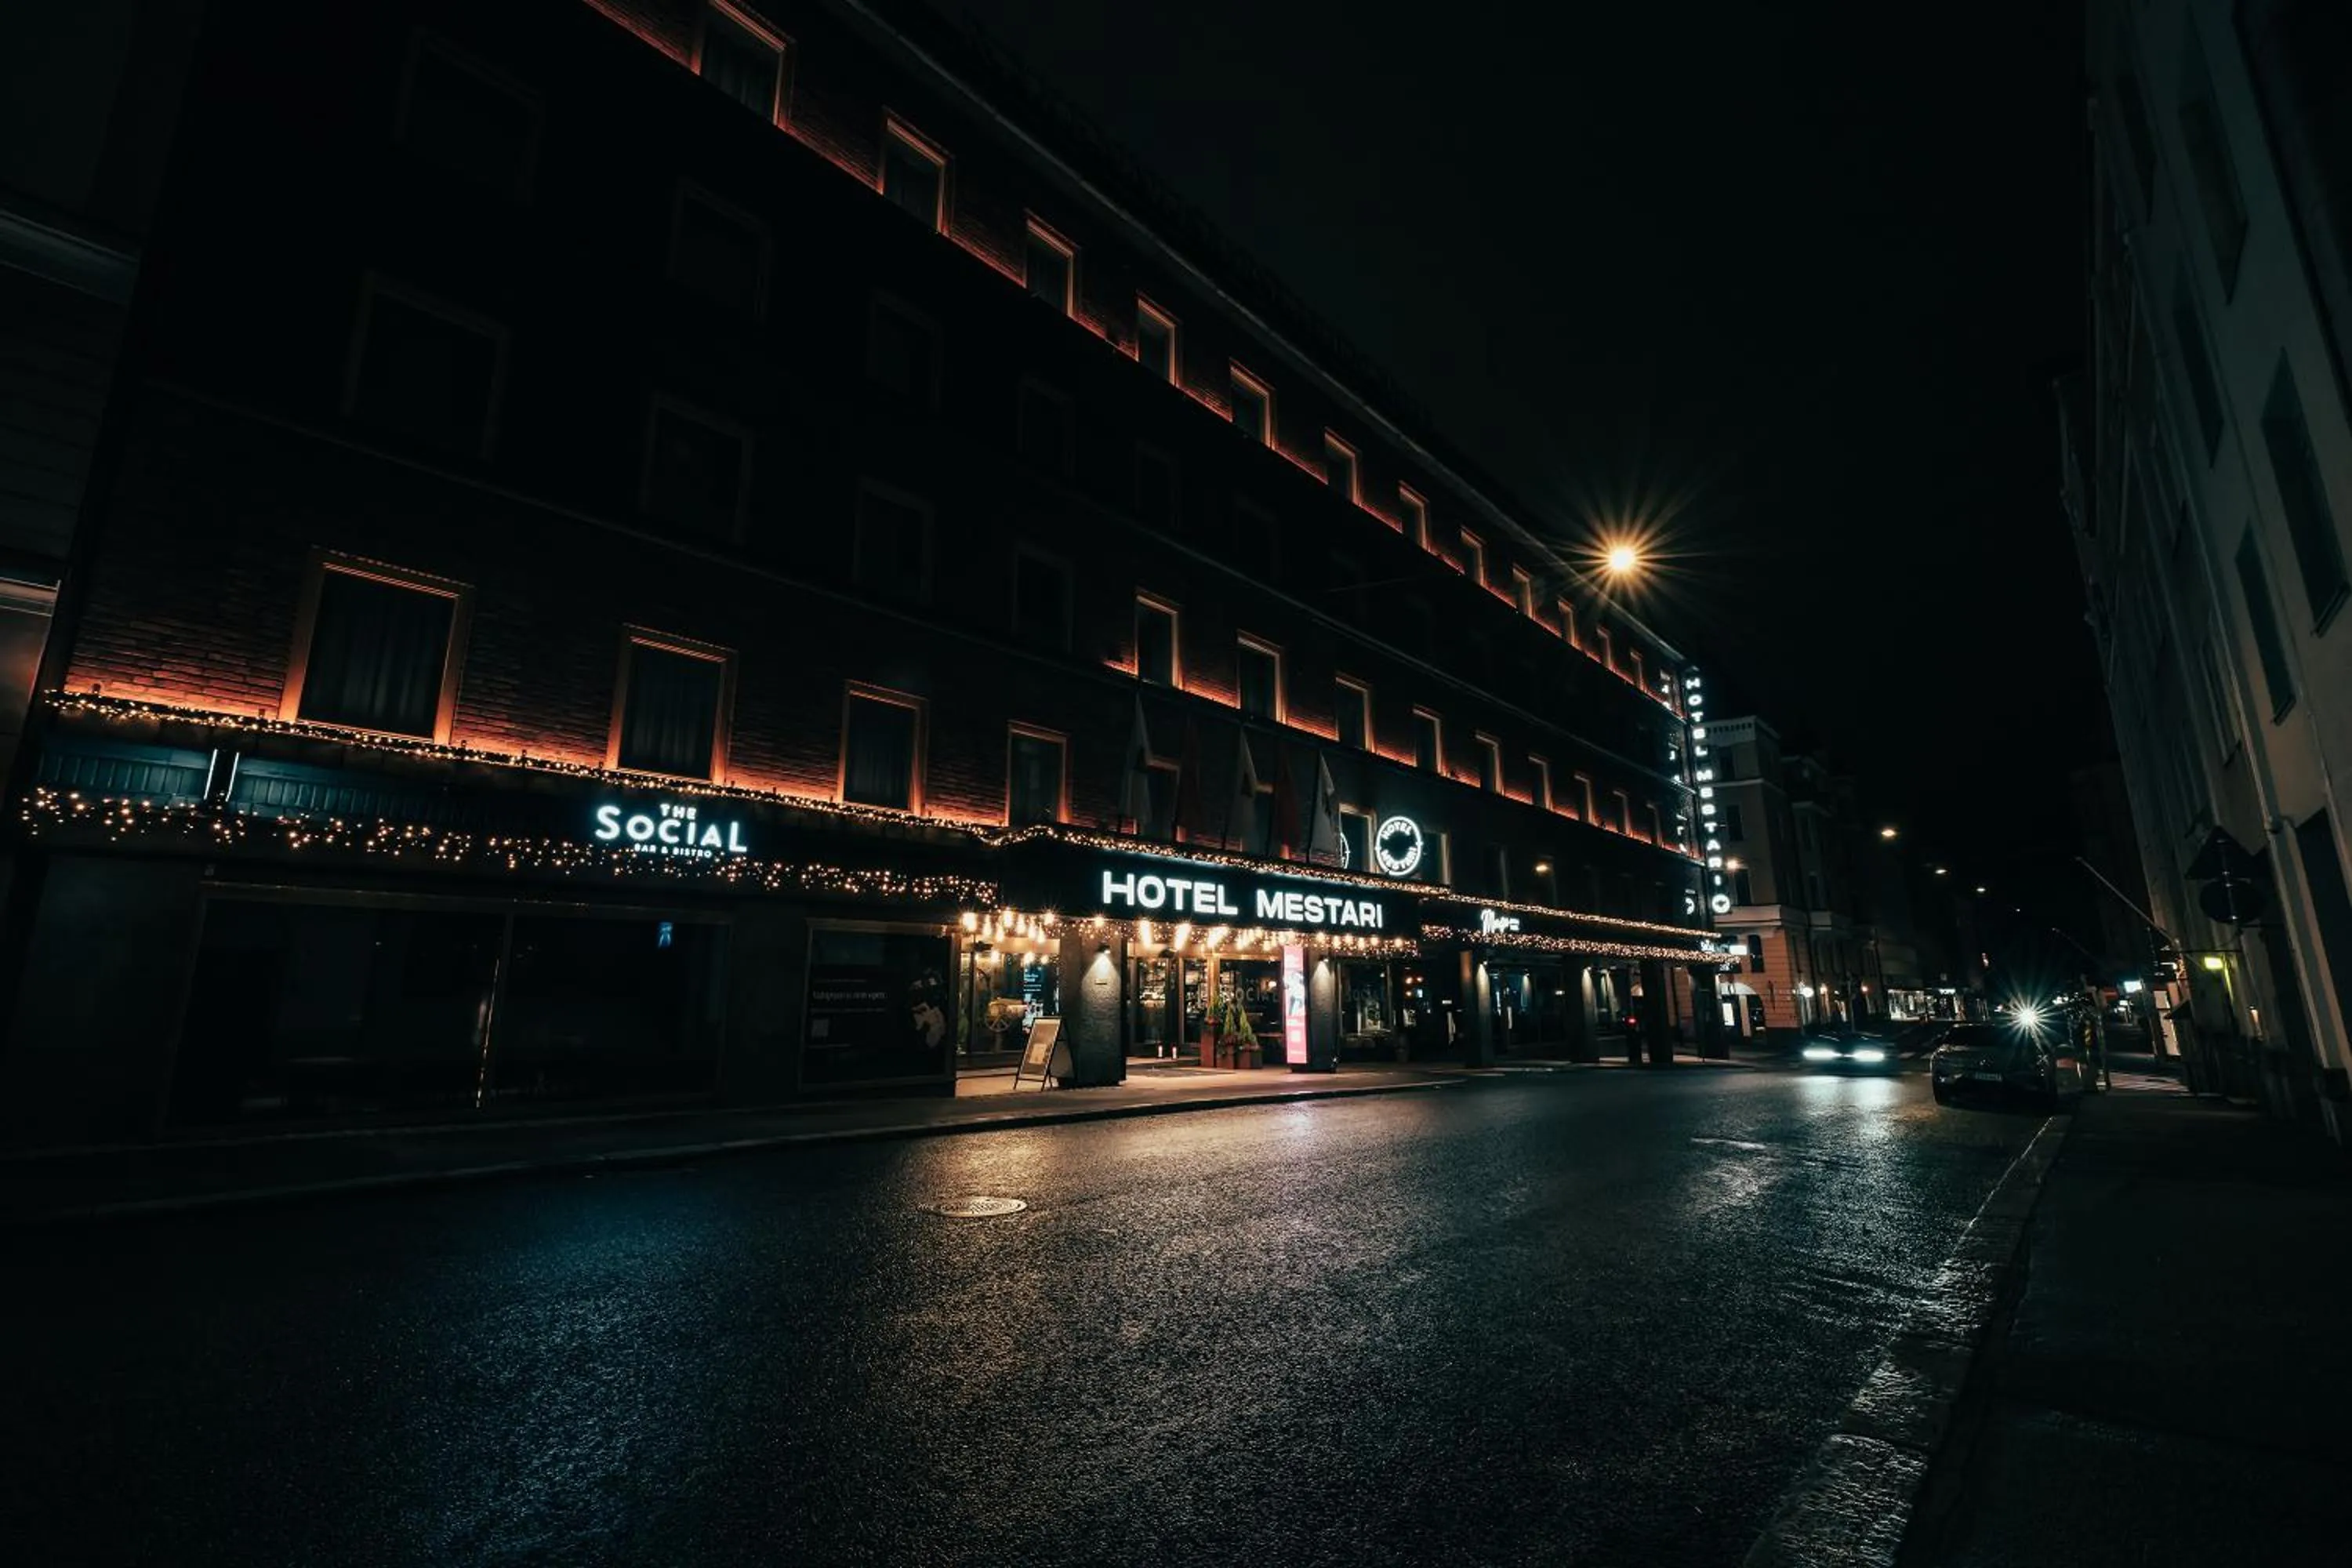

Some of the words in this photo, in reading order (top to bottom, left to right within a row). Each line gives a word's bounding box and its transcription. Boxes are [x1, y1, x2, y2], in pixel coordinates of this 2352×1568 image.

[1686, 677, 1708, 757] HOTEL
[659, 803, 697, 820] THE
[1381, 821, 1413, 840] HOTEL
[1696, 768, 1723, 887] MESTARI
[633, 843, 657, 854] BAR
[673, 847, 713, 858] BISTRO
[1102, 870, 1239, 916] HOTEL
[1256, 888, 1384, 928] MESTARI
